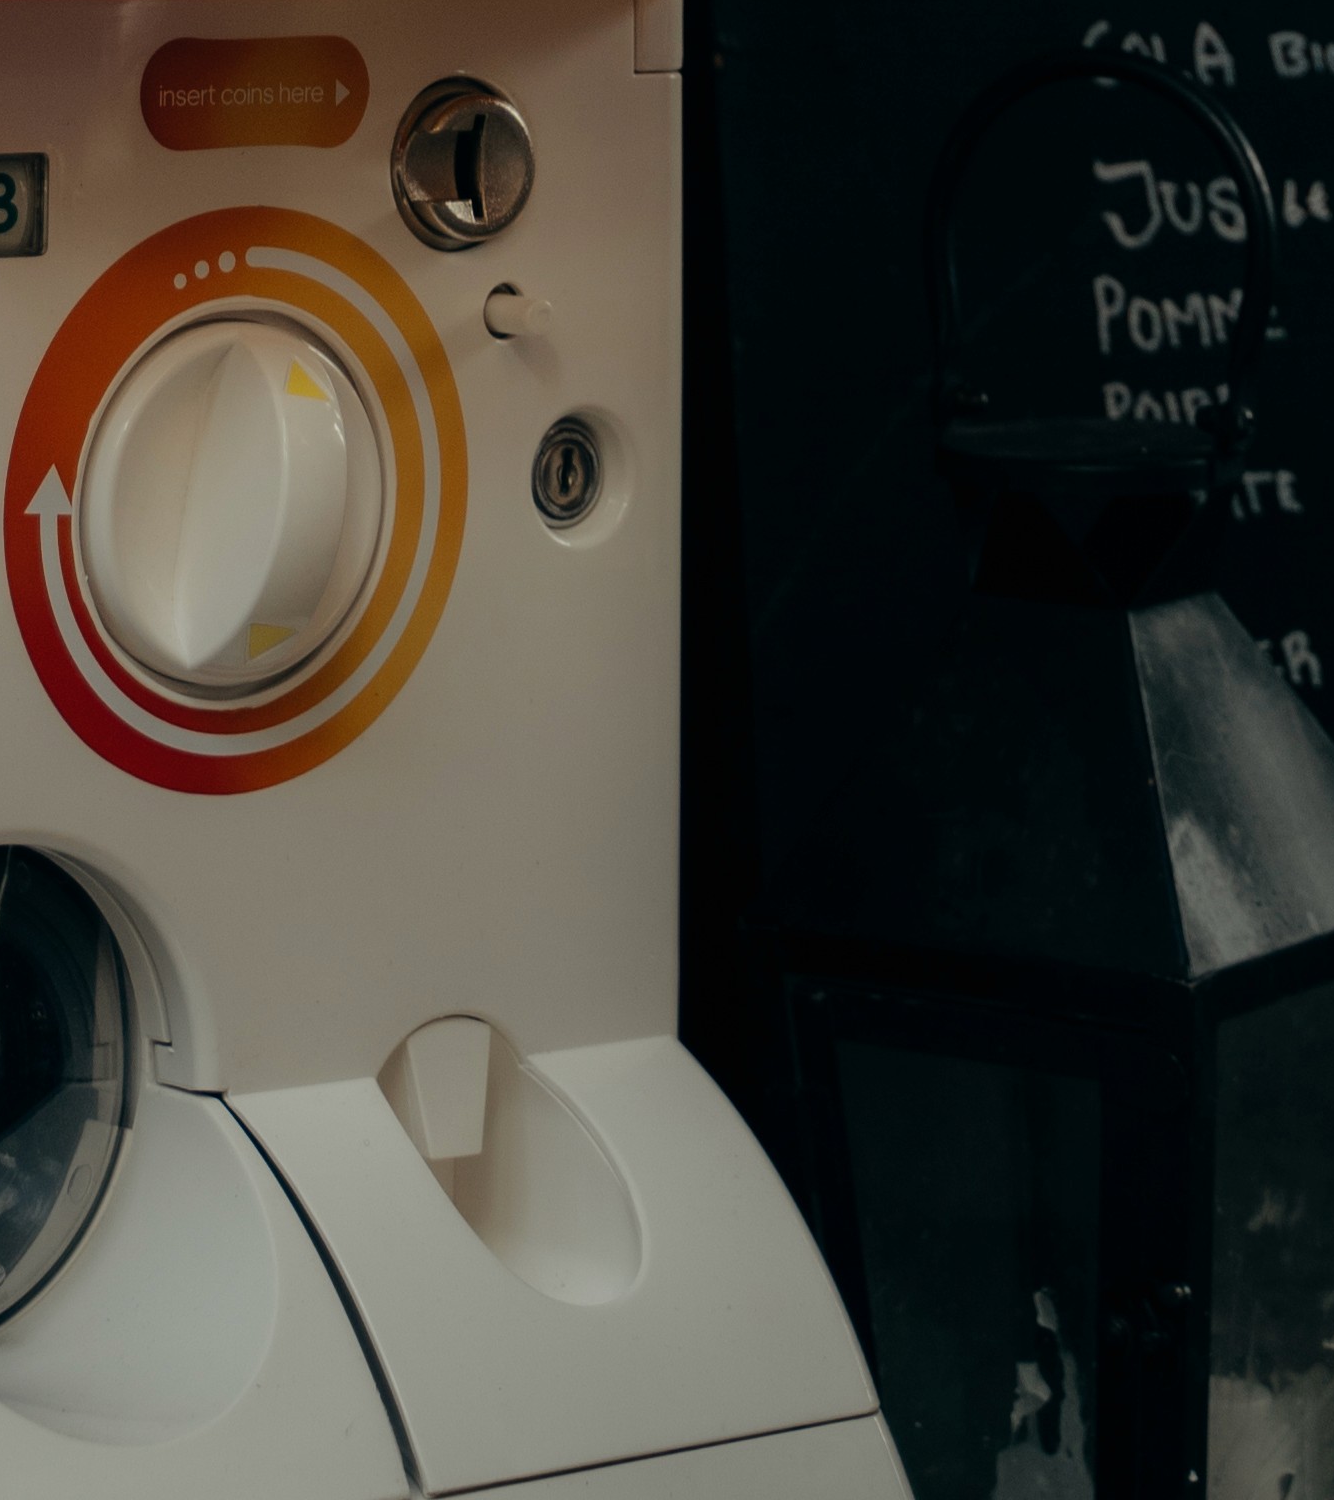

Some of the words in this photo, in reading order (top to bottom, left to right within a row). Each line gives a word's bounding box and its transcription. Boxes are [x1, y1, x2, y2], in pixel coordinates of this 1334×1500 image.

[159, 84, 216, 108] insert
[220, 82, 273, 106] coins
[277, 80, 324, 105] here
[1092, 159, 1249, 250] JUS
[1092, 273, 1287, 355] POMM
